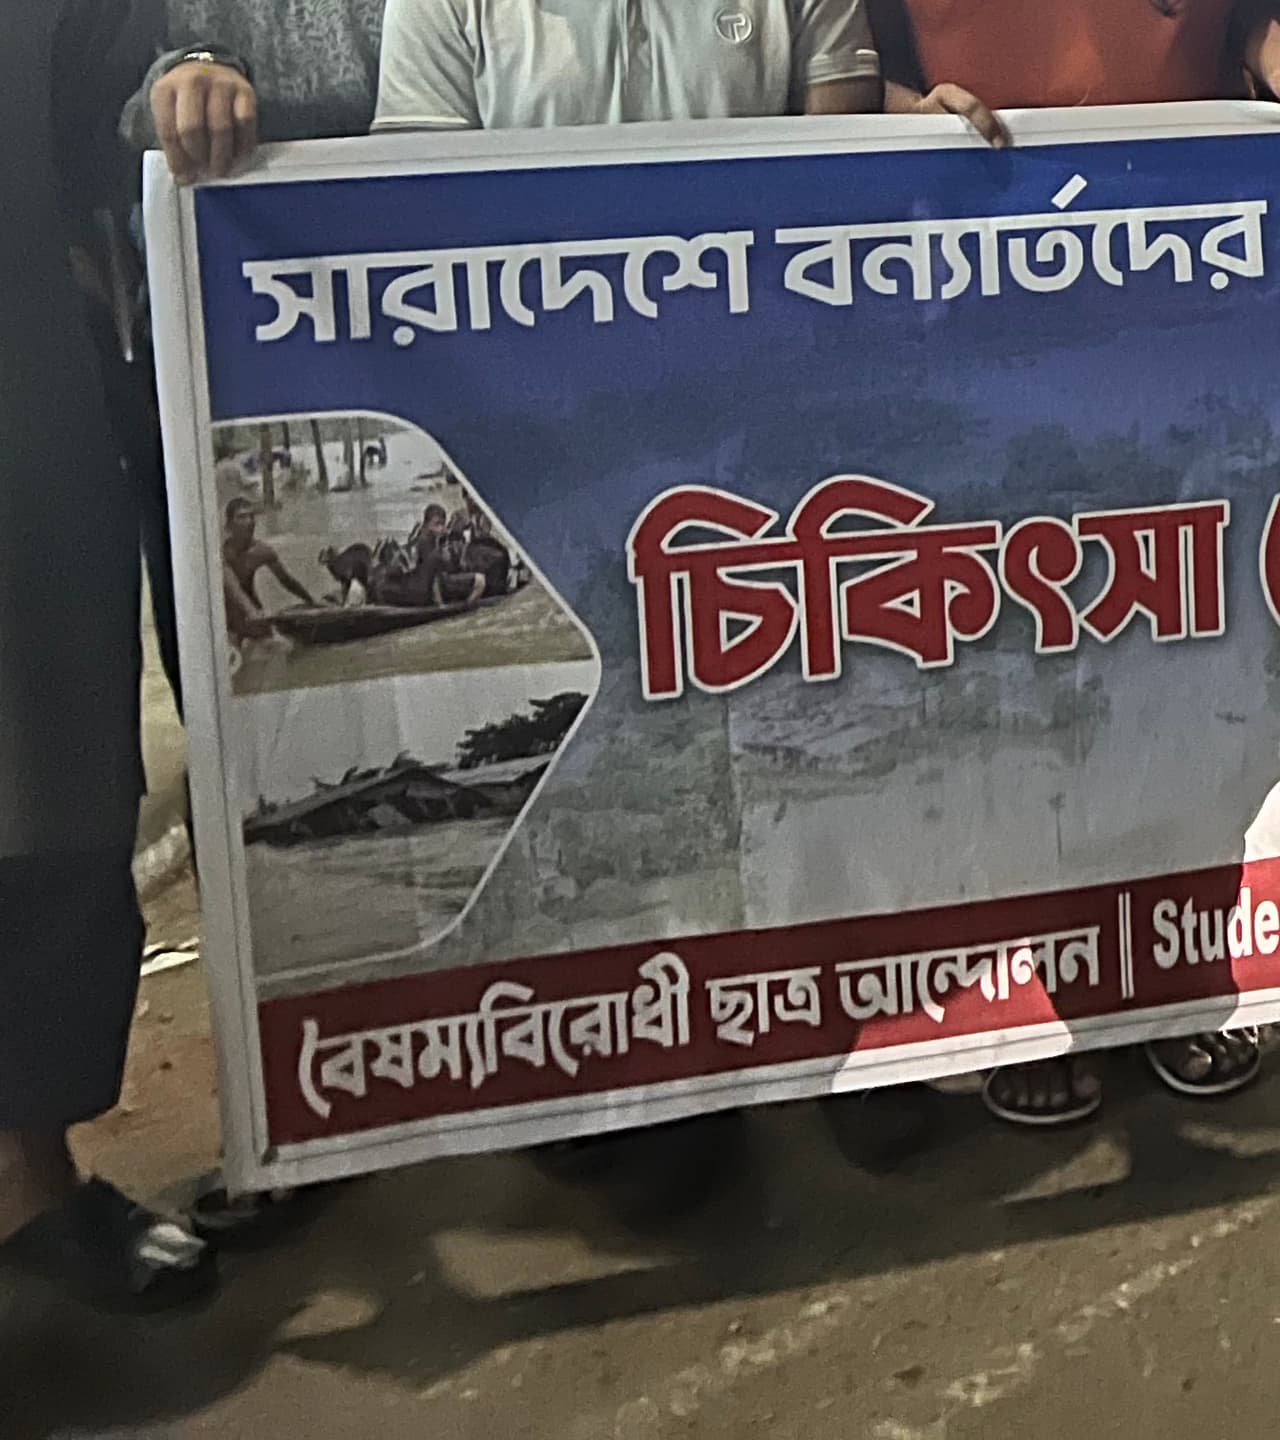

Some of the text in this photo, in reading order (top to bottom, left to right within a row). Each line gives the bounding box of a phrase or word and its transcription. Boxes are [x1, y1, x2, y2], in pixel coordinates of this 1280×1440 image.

[243, 231, 753, 346] সারাদেশে
[775, 174, 1267, 306] বন্যার্তদের
[627, 474, 1229, 700] চিকিৎসা
[299, 926, 1100, 1117] বৈষম্যবিরোধী ছাত্র আন্দোলন
